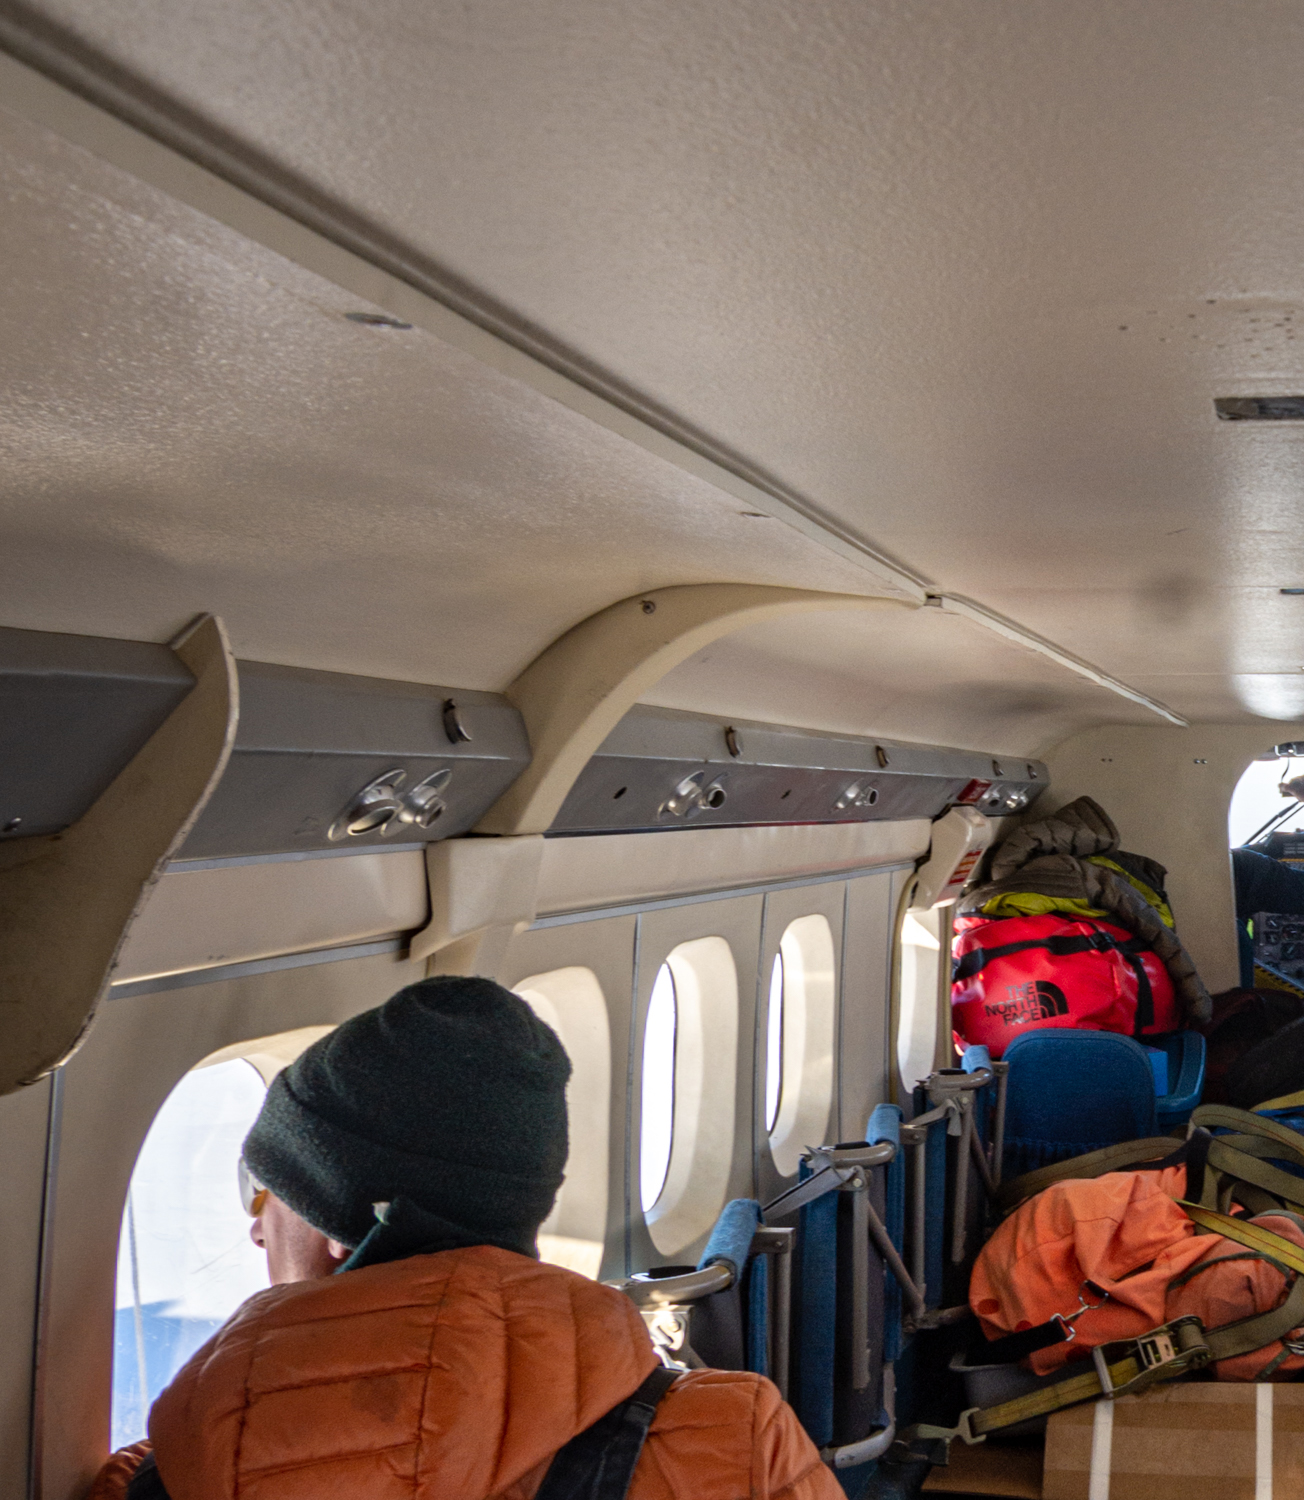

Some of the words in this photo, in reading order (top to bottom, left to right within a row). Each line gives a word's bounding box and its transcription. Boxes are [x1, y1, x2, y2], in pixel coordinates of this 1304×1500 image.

[1005, 981, 1035, 999] THE
[984, 994, 1039, 1018] NORTH
[1003, 1008, 1041, 1027] FACE
